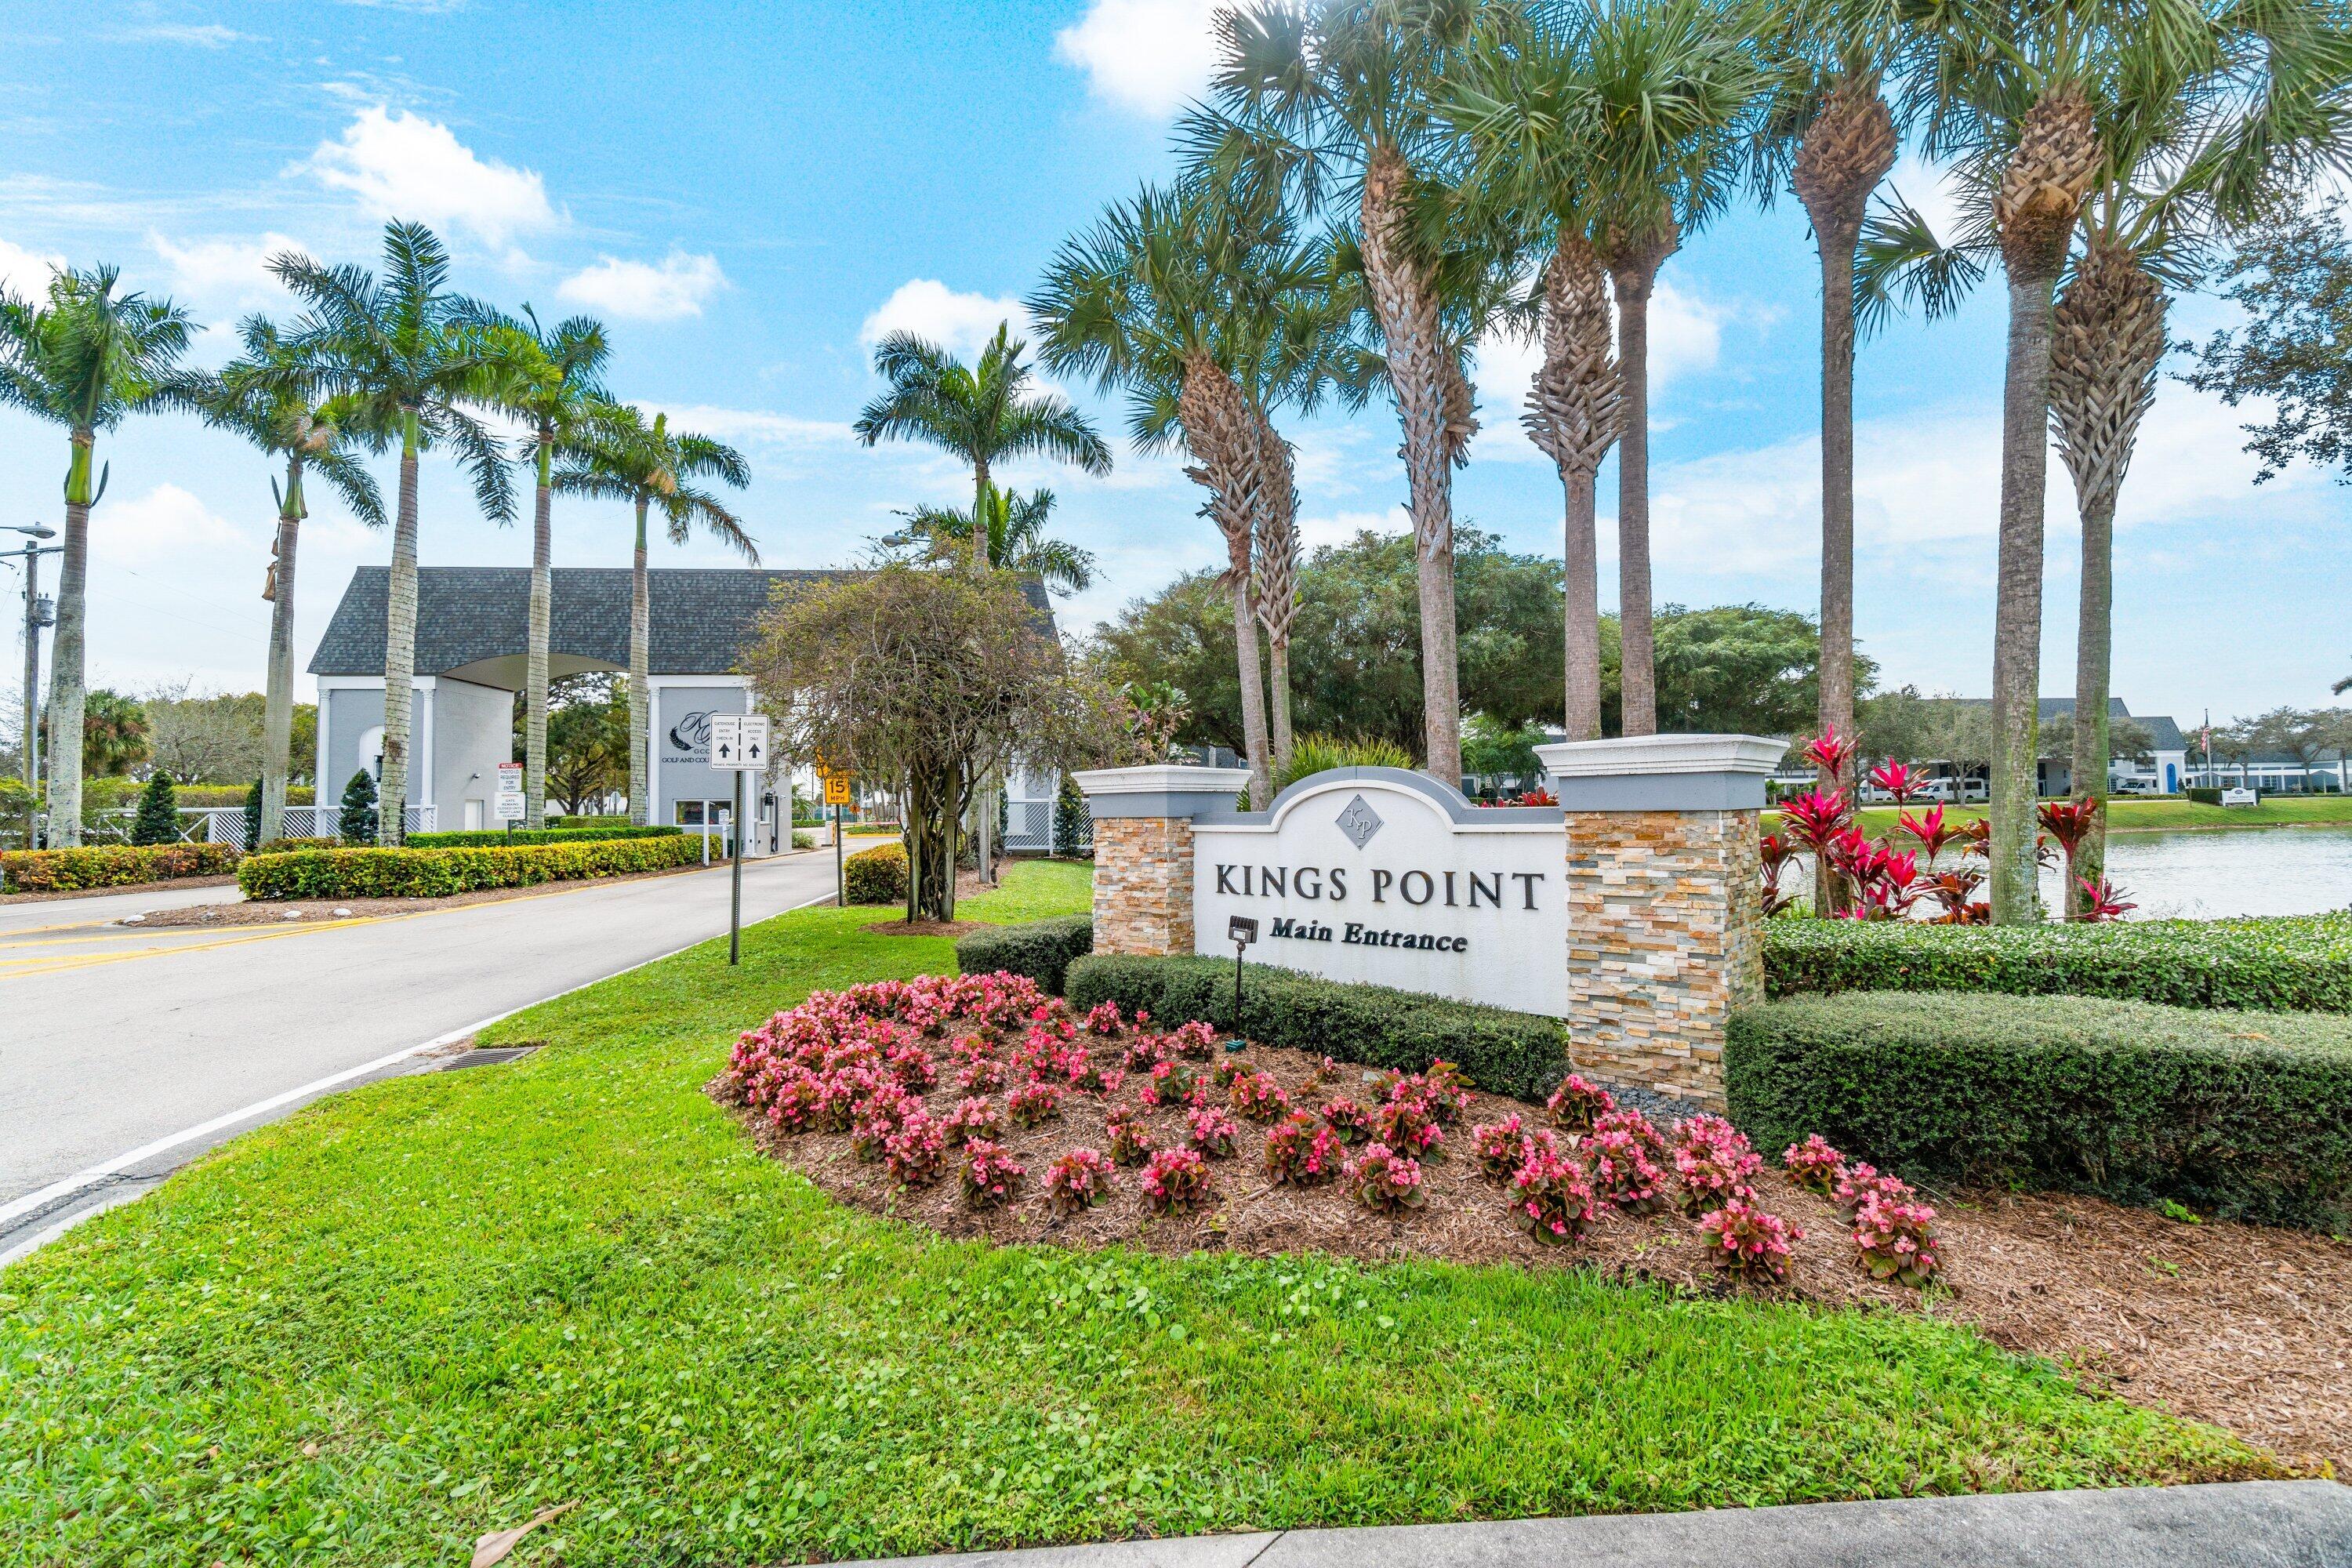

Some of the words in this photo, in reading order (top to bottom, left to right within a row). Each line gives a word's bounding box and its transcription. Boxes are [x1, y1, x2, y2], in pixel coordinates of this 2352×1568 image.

[829, 780, 845, 793] 15
[1214, 864, 1347, 901] KINGS
[1370, 869, 1544, 909] POINT
[1269, 916, 1333, 942] Main
[1341, 922, 1468, 953] Entrance
